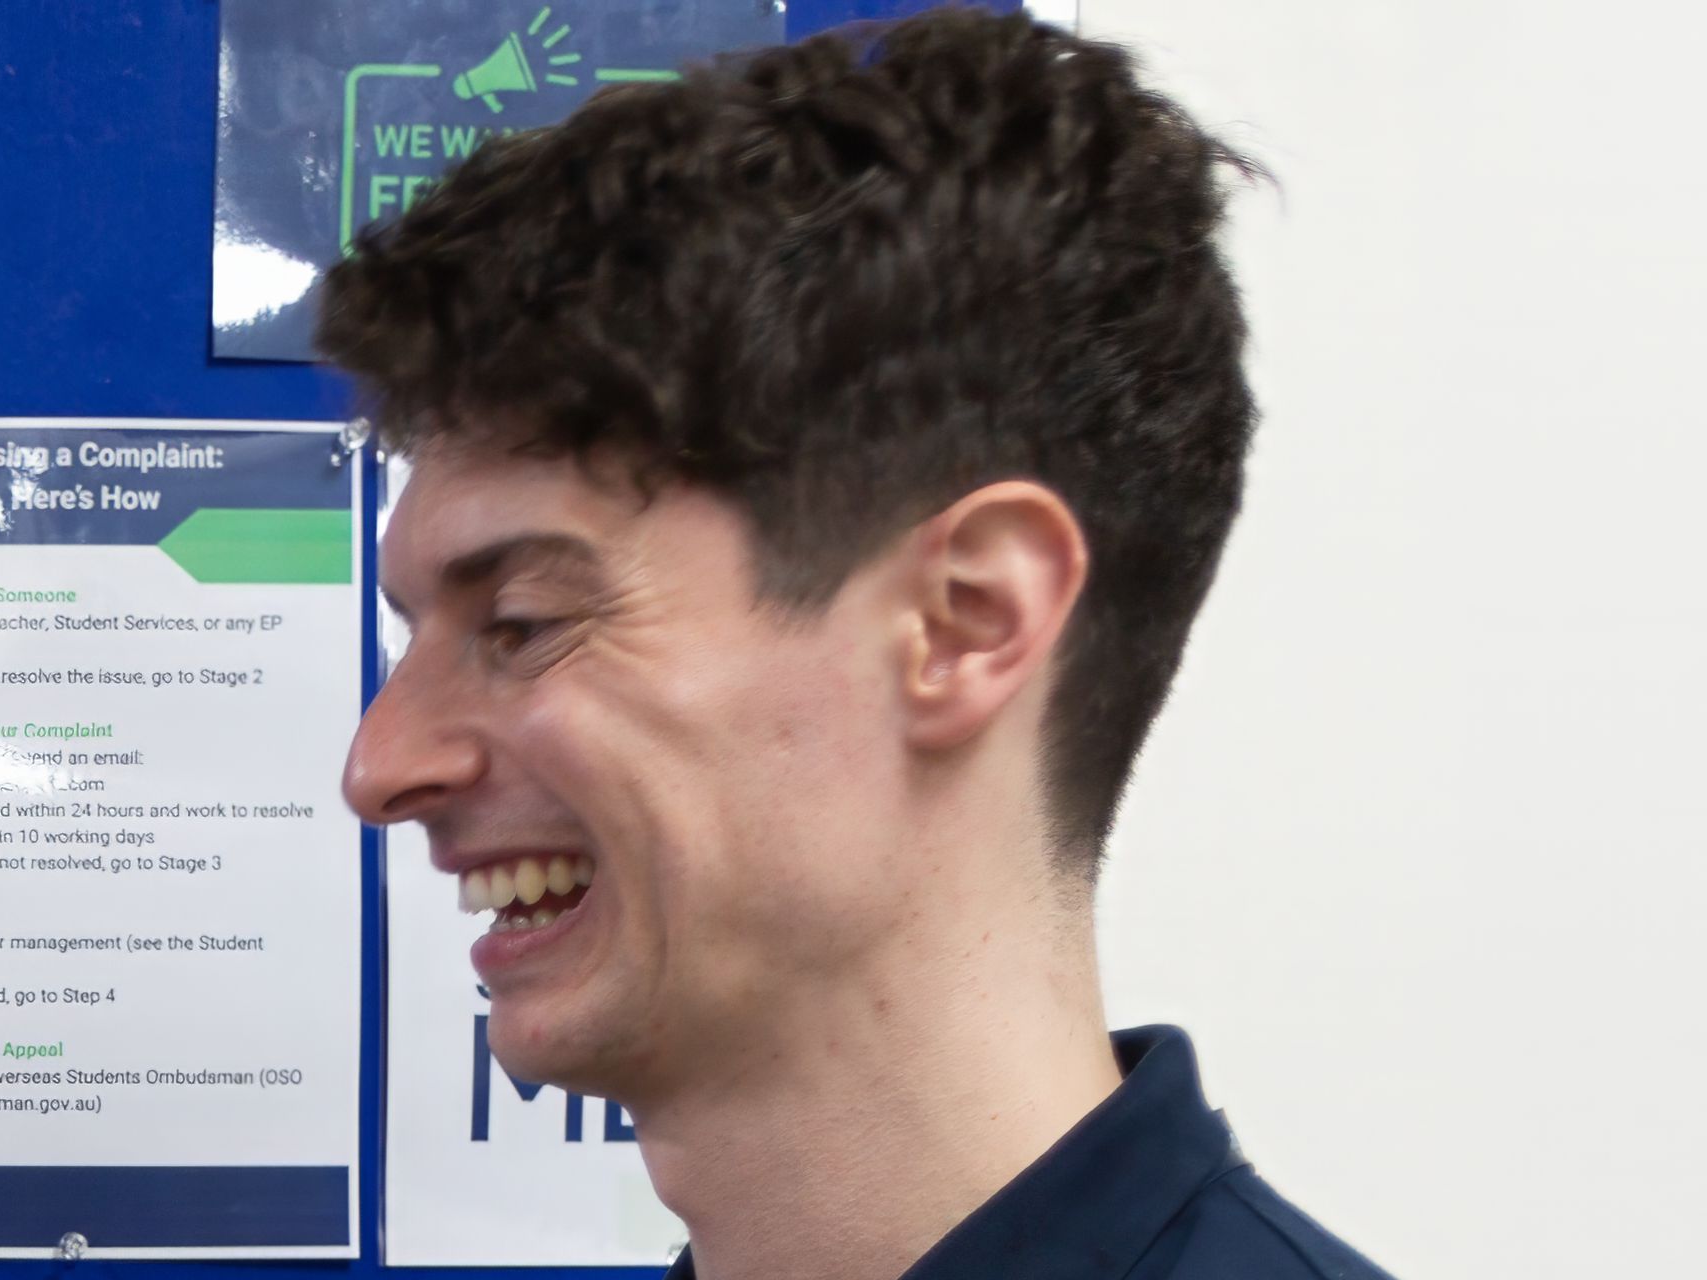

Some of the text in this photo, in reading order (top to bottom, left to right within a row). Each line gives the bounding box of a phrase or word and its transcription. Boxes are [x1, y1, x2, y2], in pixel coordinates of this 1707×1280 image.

[374, 124, 432, 159] WE
[54, 448, 73, 468] a
[78, 441, 225, 473] Complaint:
[10, 484, 162, 511] Here's How
[2, 1041, 63, 1060] Appeal
[65, 1069, 141, 1085] Students
[146, 1069, 254, 1085] Ombudsman
[259, 1069, 302, 1087] (OSO
